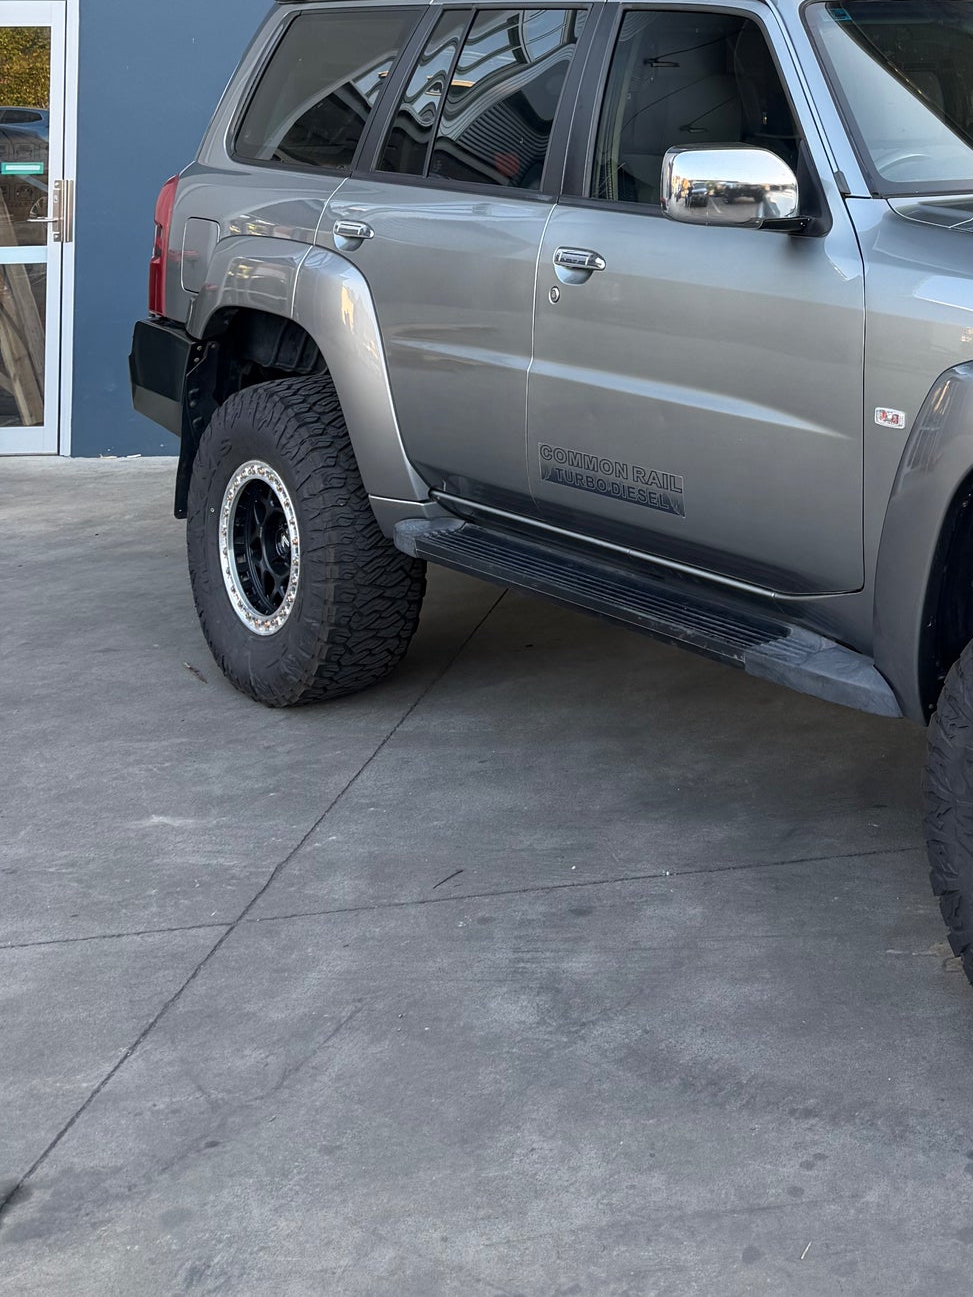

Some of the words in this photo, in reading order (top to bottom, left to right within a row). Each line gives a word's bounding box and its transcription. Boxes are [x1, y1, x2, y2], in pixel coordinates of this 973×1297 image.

[539, 444, 629, 480] COMMON
[632, 465, 683, 494] RAIL
[554, 467, 609, 493] TURBO
[610, 481, 669, 510] DIESEL
